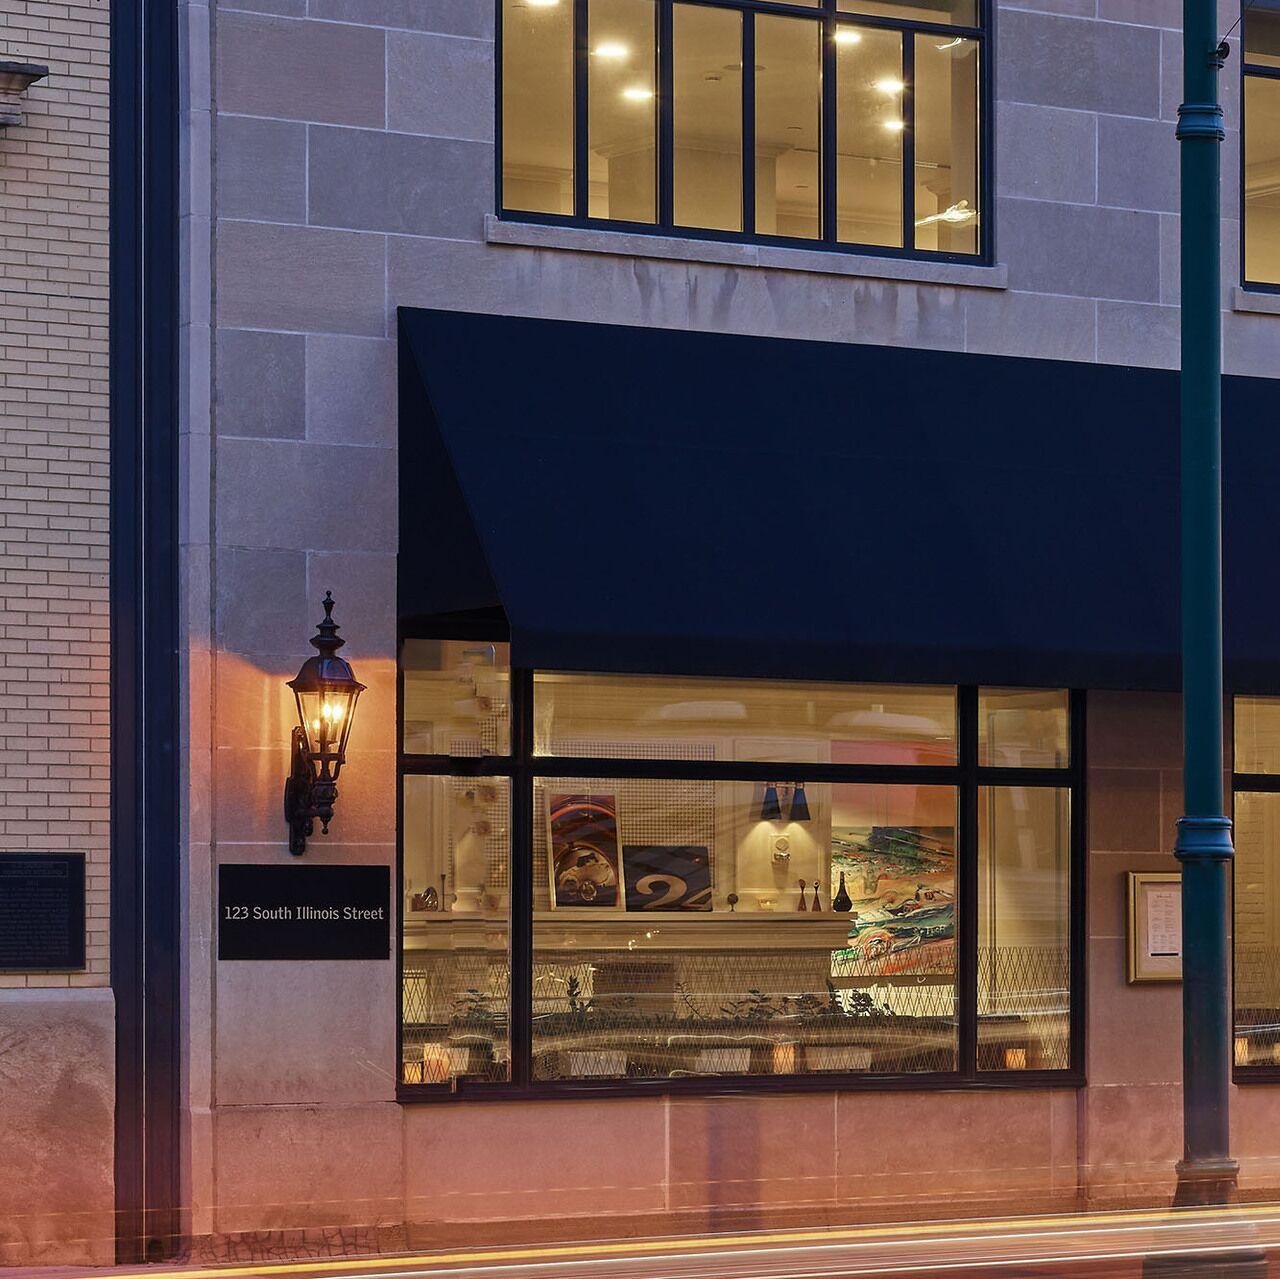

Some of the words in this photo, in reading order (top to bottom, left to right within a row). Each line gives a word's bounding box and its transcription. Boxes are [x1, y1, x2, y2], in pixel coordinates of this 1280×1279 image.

[224, 906, 249, 920] 123
[252, 906, 292, 920] South
[296, 906, 340, 920] Illinois
[343, 906, 384, 920] Street
